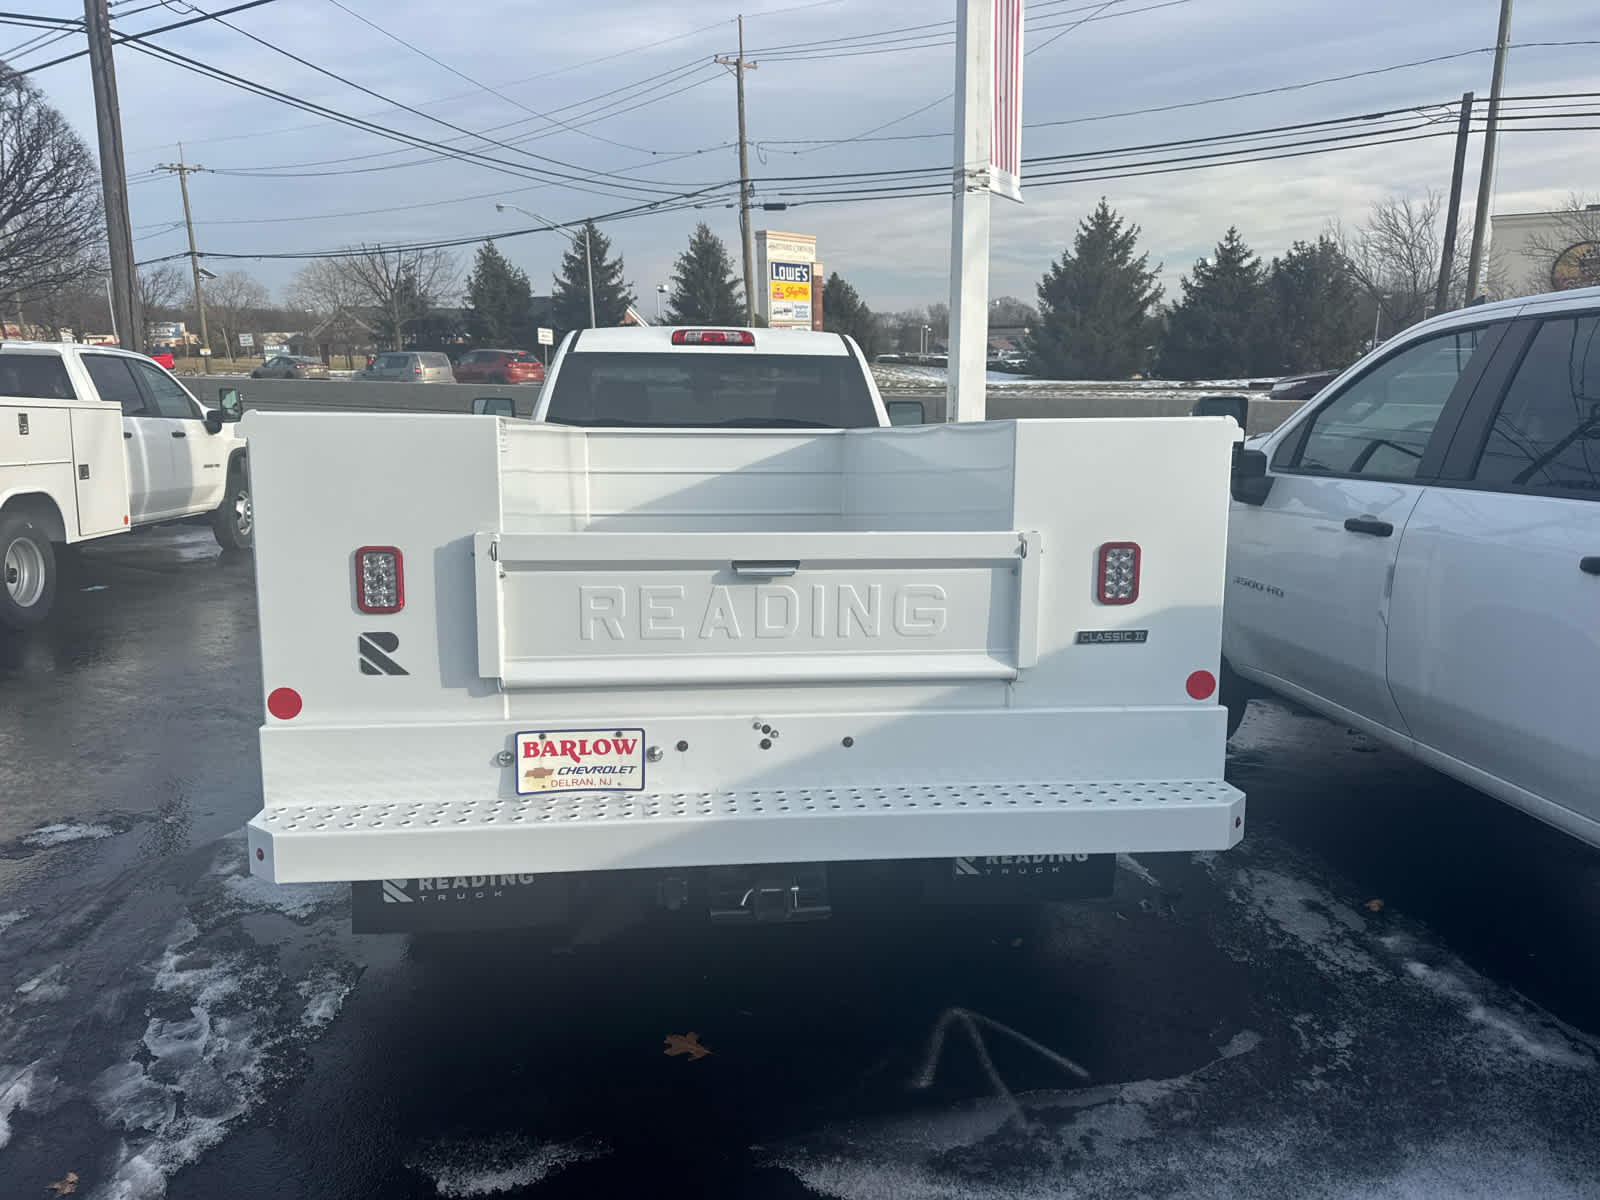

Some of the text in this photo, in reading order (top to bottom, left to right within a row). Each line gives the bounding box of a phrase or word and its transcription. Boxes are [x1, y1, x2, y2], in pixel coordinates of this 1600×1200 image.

[772, 263, 808, 281] LOWE'S
[578, 584, 948, 640] READING
[1080, 631, 1132, 641] CLASSIC
[523, 738, 637, 763] BARLOW
[557, 765, 637, 776] CHEVROLET
[551, 777, 612, 788] DELRAN, NJ
[418, 873, 535, 891] READING
[419, 890, 503, 902] TRUCK
